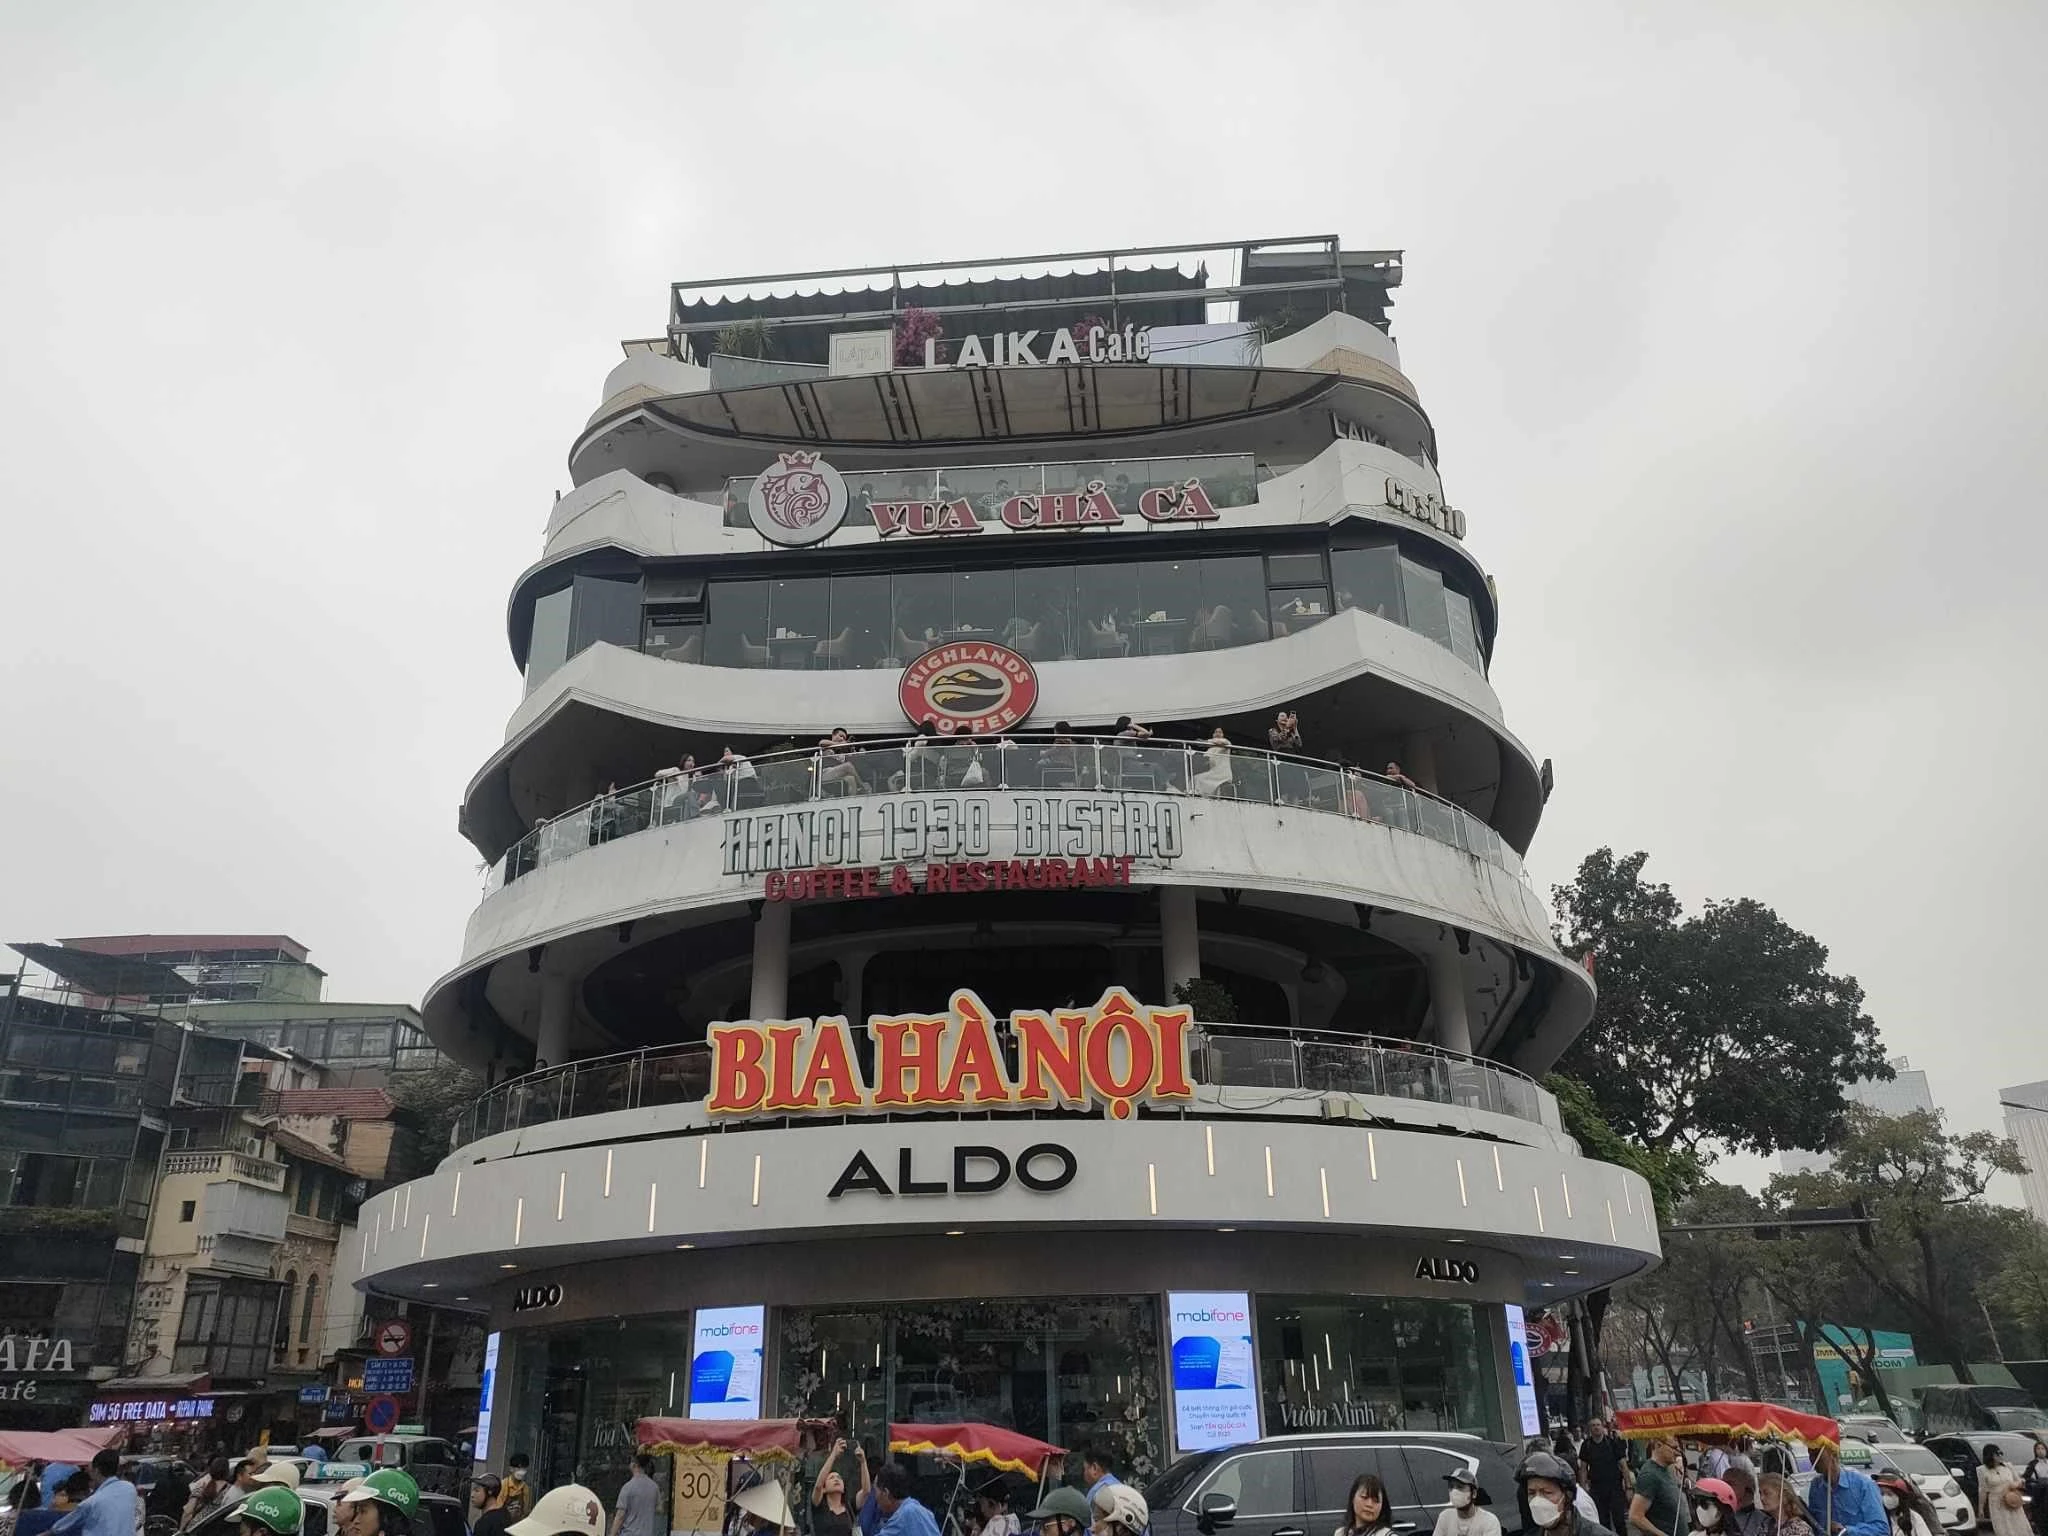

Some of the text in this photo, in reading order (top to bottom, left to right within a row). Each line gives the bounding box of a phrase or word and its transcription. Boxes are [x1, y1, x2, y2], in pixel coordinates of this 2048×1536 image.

[925, 323, 1150, 369] LAIKA Café
[866, 477, 1220, 535] VUA CHẢ CÁ
[906, 647, 1029, 688] HIGHLANDS
[722, 798, 1183, 875] HANOI 1930 BISTRO
[765, 855, 1135, 902] COFFEE & RESTAURANT
[827, 1143, 1078, 1199] ALDO
[1414, 1256, 1479, 1285] ALDO
[514, 1285, 563, 1312] ALDO
[1177, 1307, 1244, 1322] mobifone
[700, 1322, 759, 1336] mobifone
[89, 1403, 107, 1422] SIM
[108, 1403, 120, 1421] 5G
[121, 1402, 143, 1420] FREE
[145, 1401, 166, 1419] DATA
[387, 1487, 410, 1505] Grab
[681, 1472, 712, 1499] 30
[255, 1501, 280, 1518] Grab
